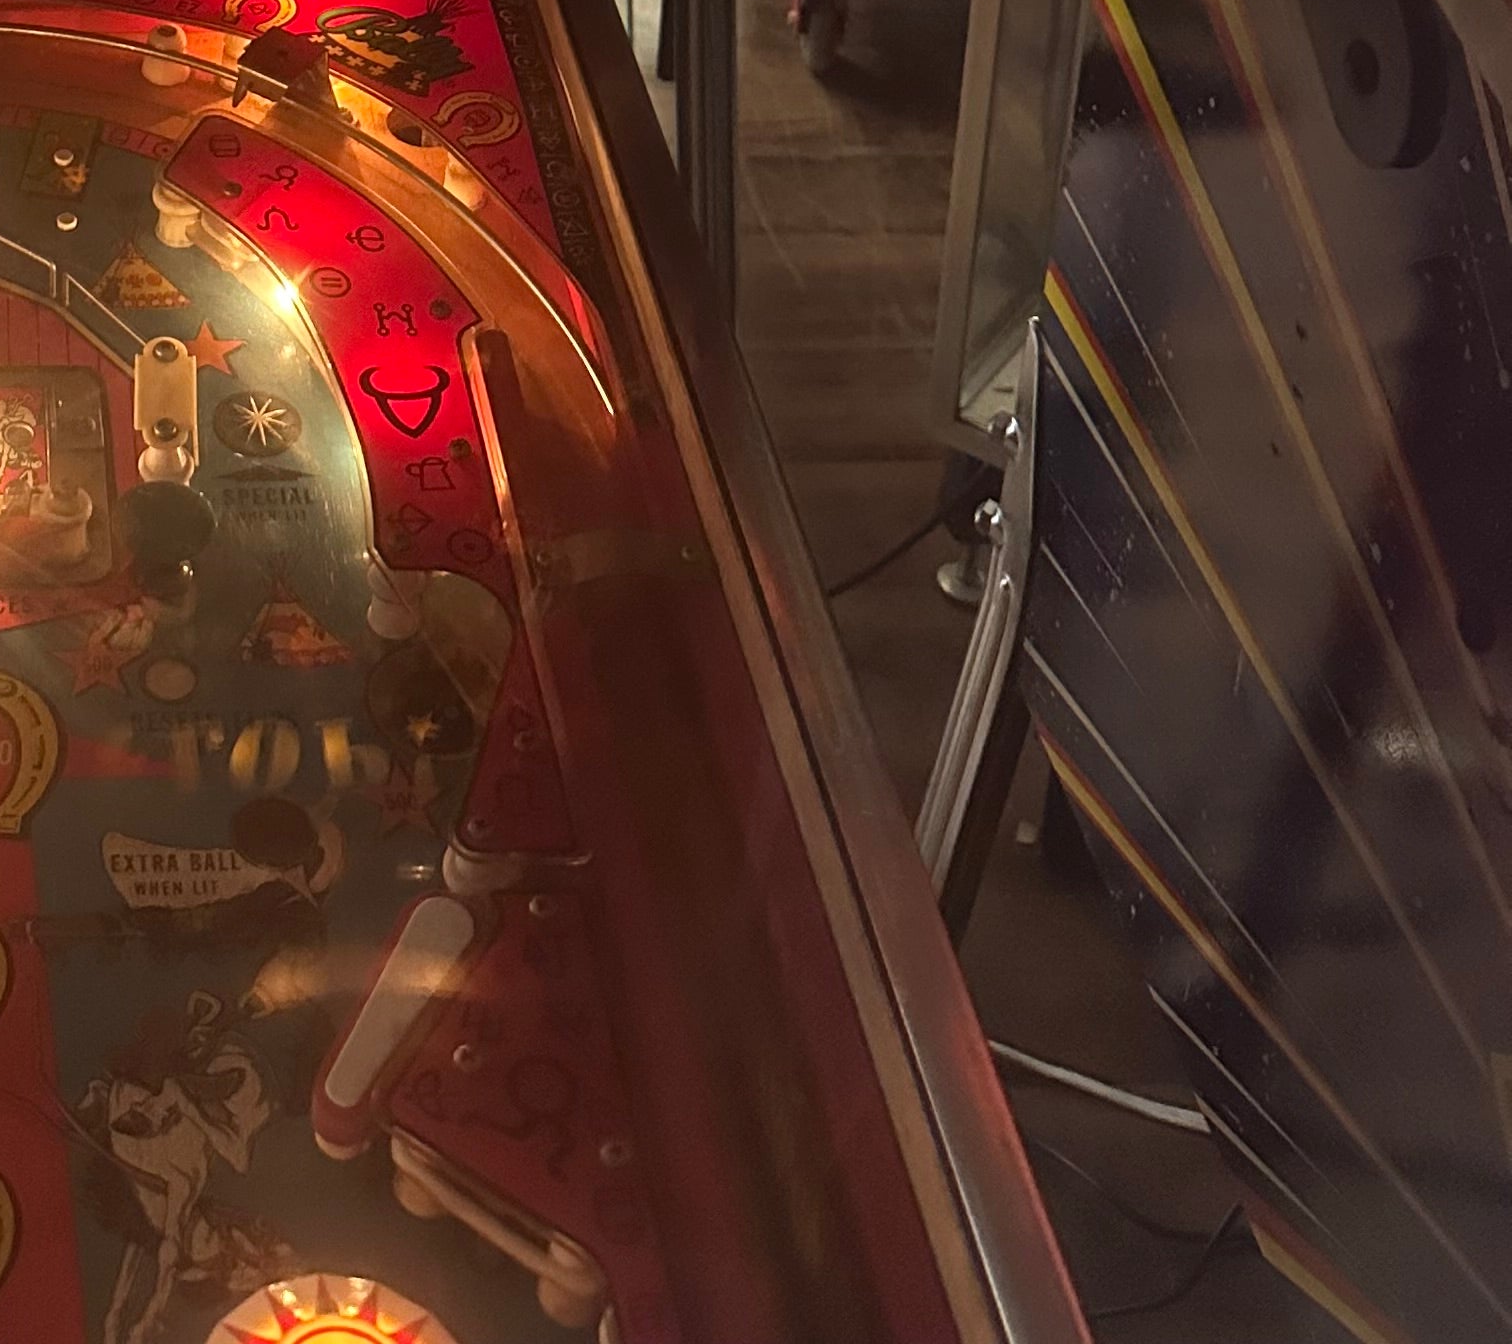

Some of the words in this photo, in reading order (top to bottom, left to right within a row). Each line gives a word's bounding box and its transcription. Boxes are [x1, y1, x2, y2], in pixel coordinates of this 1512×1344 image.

[221, 487, 314, 506] SPECIAL
[109, 853, 180, 873] EXTRA
[189, 852, 242, 872] BALL
[134, 879, 184, 896] WHEN
[192, 879, 218, 895] LIT
